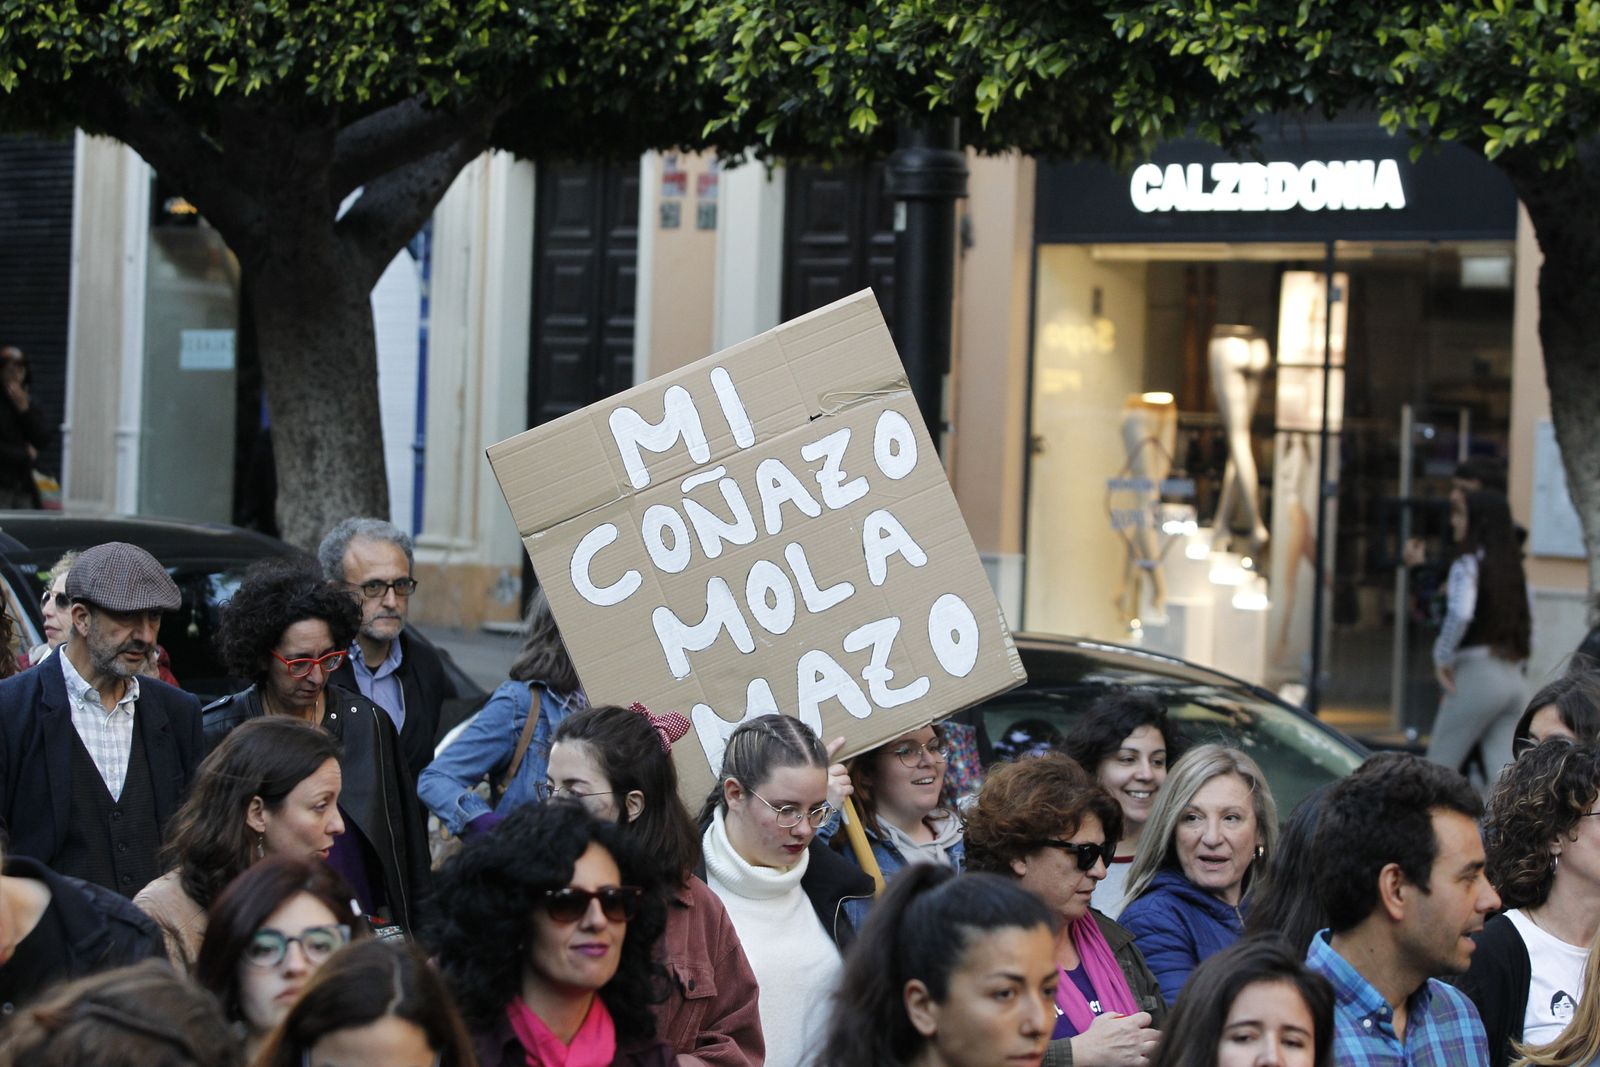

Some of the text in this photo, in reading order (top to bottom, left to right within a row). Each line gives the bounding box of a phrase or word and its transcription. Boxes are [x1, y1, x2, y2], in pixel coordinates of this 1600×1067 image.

[1130, 159, 1406, 213] CALZEDONIA
[608, 366, 756, 490] MI
[570, 409, 918, 607] COÑAZO
[651, 509, 928, 680] MOLA
